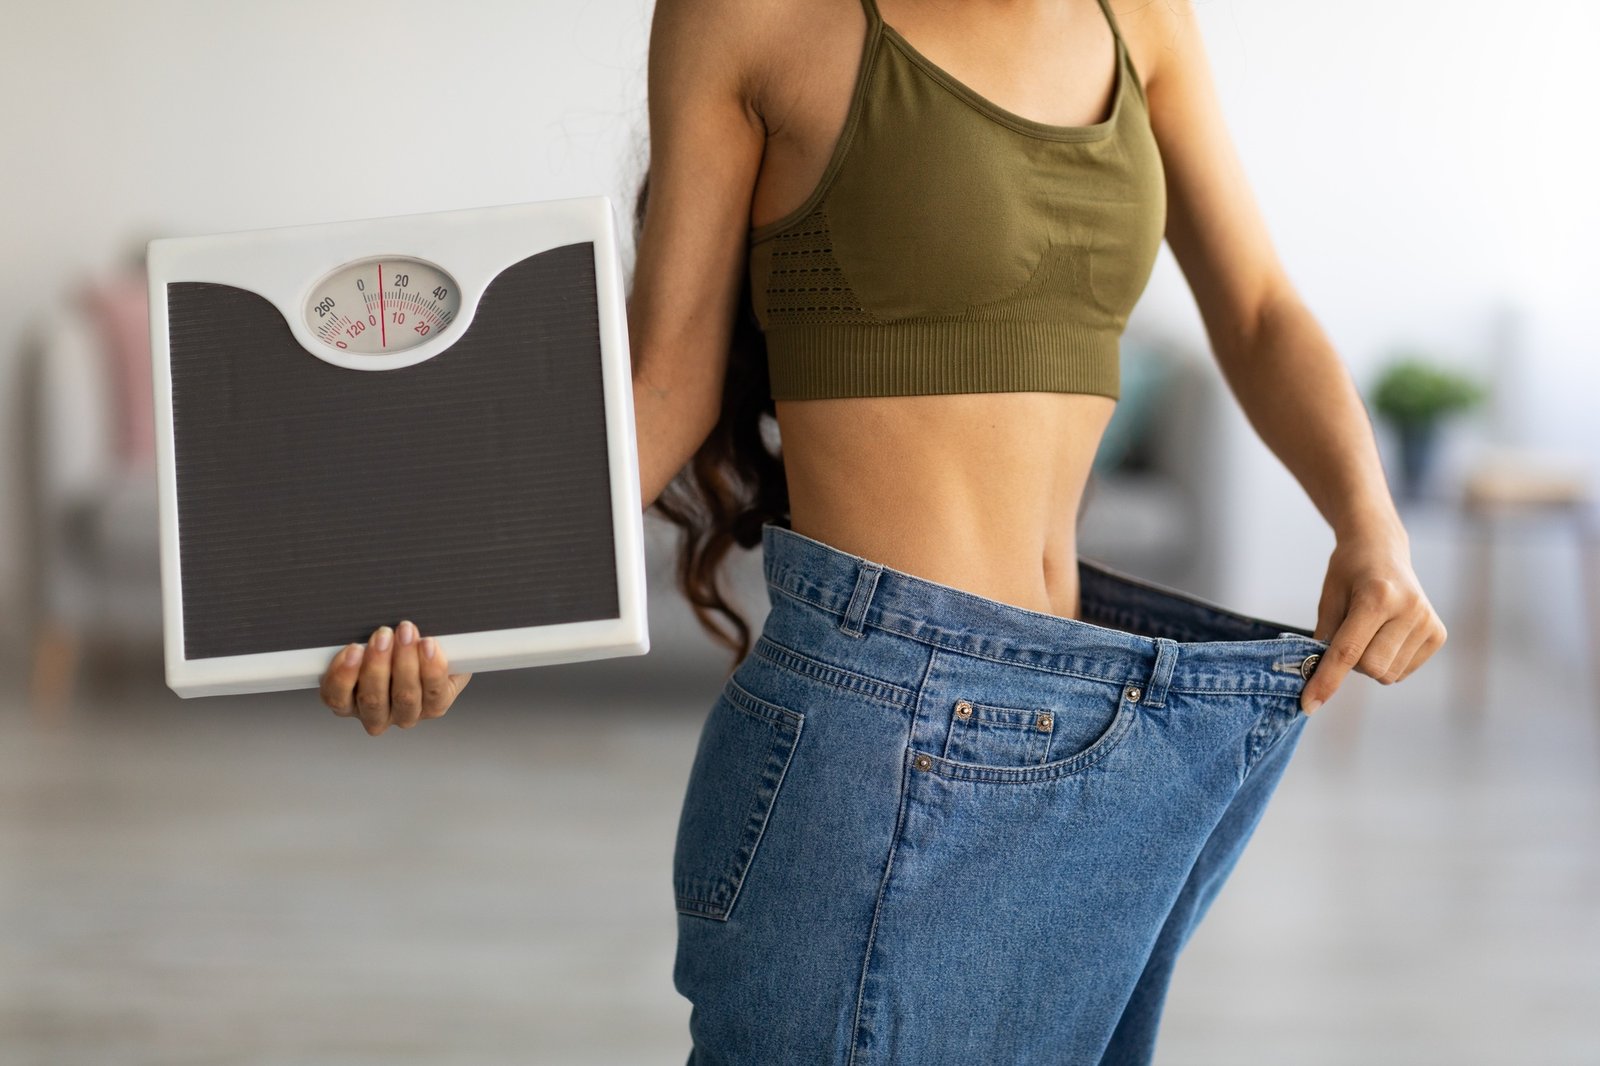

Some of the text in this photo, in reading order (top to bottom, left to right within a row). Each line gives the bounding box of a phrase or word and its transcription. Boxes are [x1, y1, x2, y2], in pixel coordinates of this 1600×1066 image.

[356, 278, 365, 291] 0
[394, 273, 409, 288] 20
[432, 286, 448, 301] 40
[314, 296, 336, 318] 260
[368, 314, 377, 327] 0
[392, 311, 405, 325] 10
[345, 320, 366, 339] 120
[414, 321, 430, 336] 20
